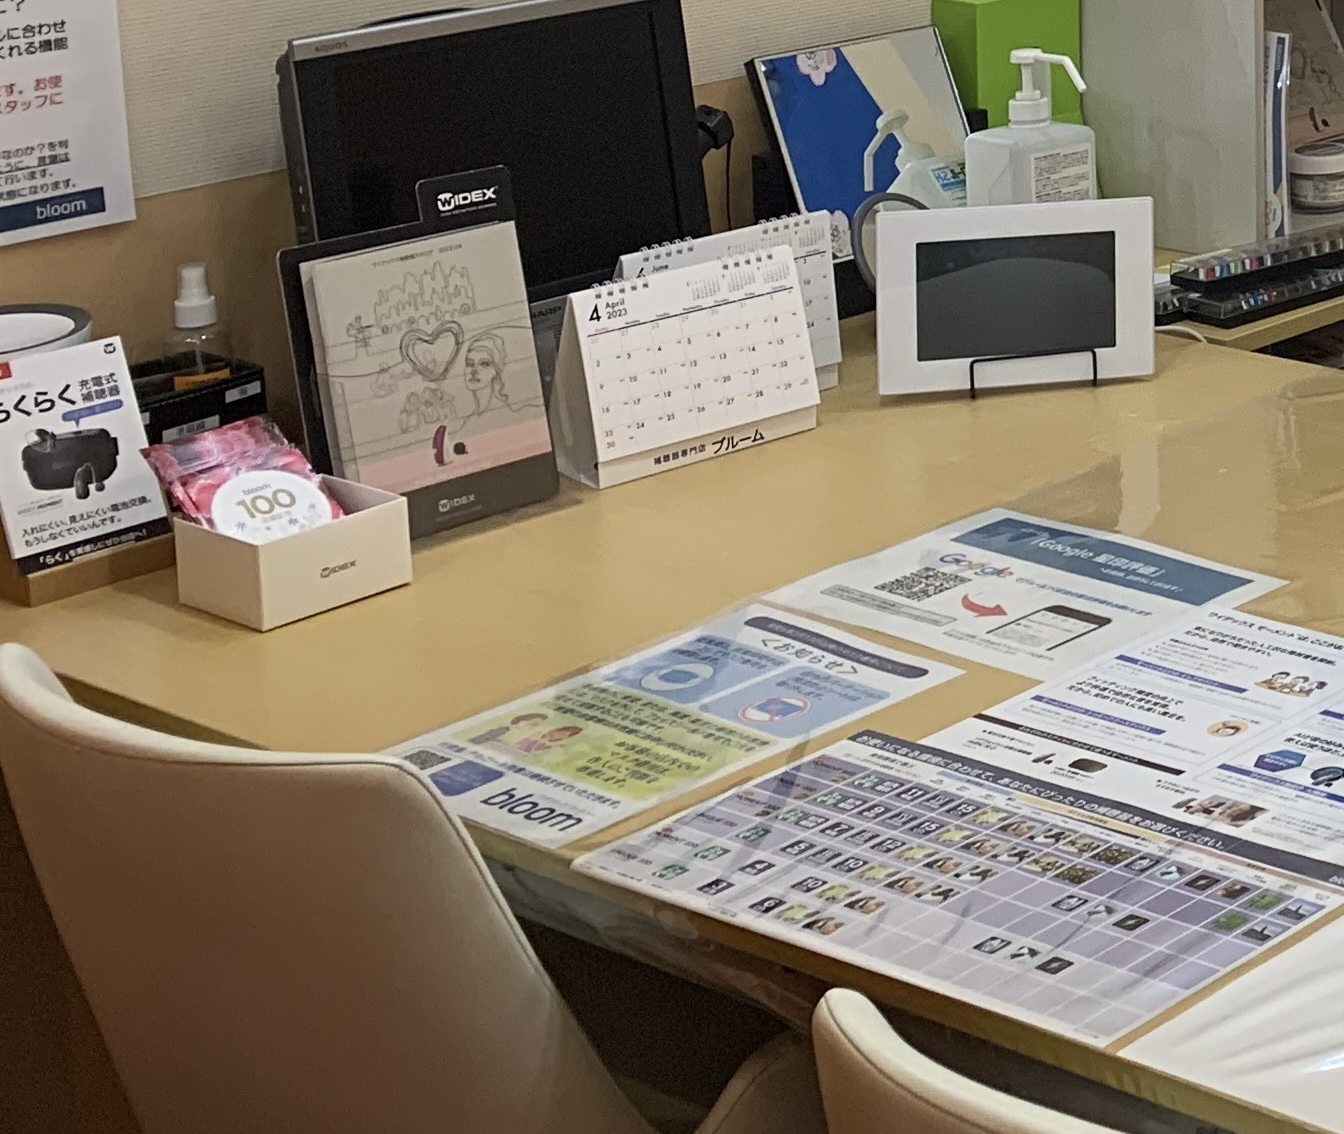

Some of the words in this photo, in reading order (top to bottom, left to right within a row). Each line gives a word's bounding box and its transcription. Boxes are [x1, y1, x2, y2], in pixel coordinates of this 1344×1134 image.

[36, 198, 87, 220] bloom
[437, 186, 497, 211] WIDEX
[588, 303, 602, 322] 4
[605, 298, 625, 310] April
[78, 372, 118, 391] 充電式
[711, 428, 766, 456] ブルーム
[235, 487, 297, 520] 100
[438, 493, 475, 512] WIDEX
[939, 552, 1014, 580] Google
[480, 787, 584, 833] bloom
